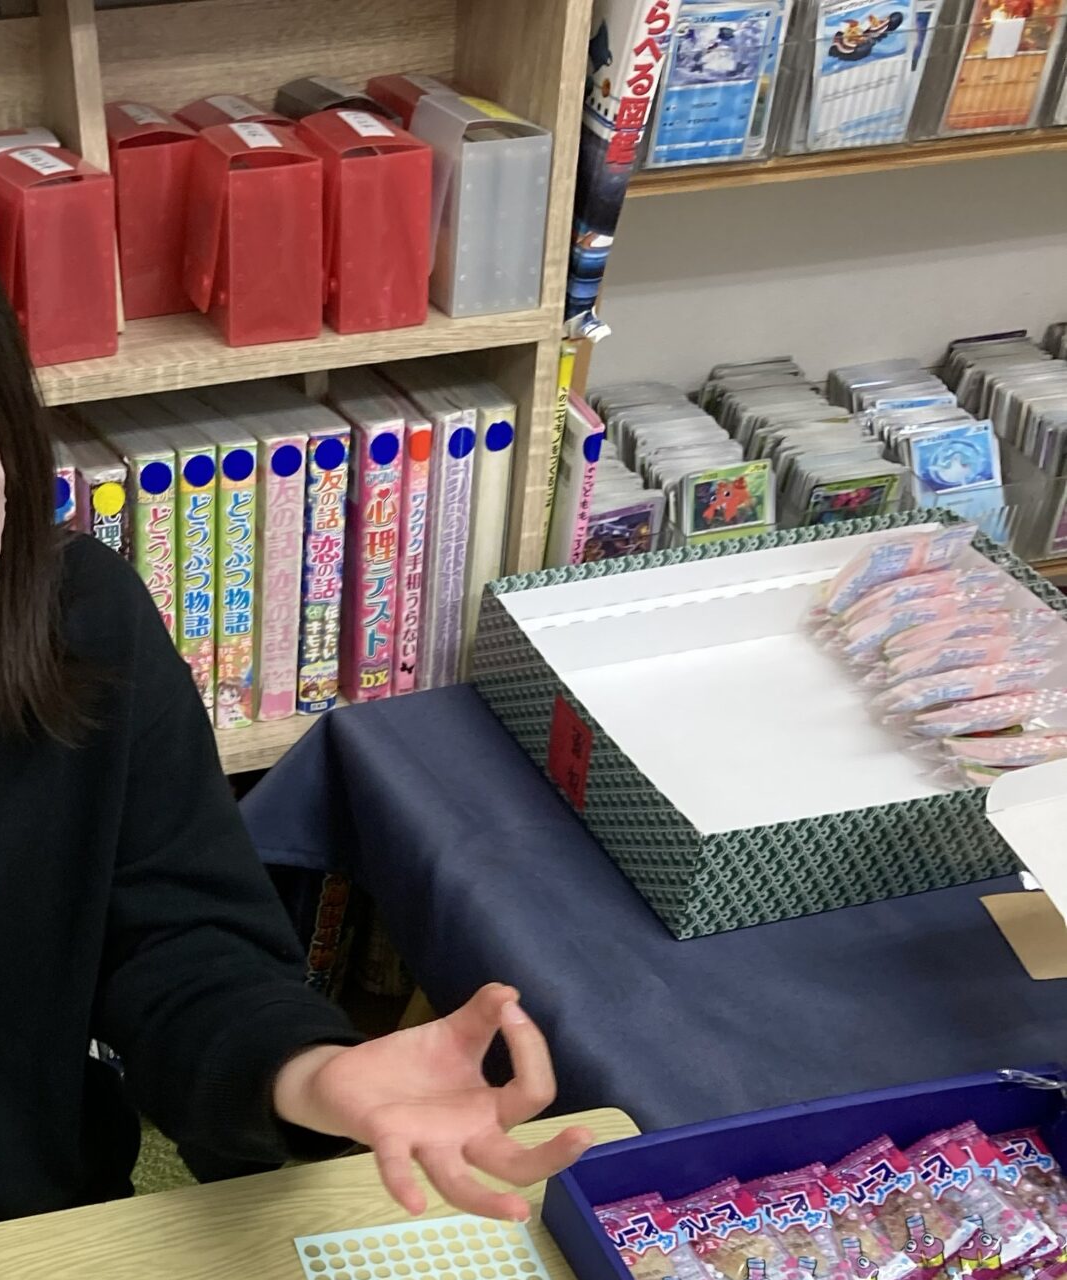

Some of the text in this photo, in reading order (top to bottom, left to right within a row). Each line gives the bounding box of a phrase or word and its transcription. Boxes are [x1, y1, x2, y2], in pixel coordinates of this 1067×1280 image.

[310, 468, 343, 600] 友の話 恋の話
[184, 494, 212, 639] どうぶつ物語
[224, 491, 254, 637] どうぶつ物語
[363, 487, 399, 658] 心理テスト
[401, 493, 427, 658] ワクワク手相うらない
[305, 621, 322, 662] キモチ
[360, 669, 389, 688] DX
[848, 1160, 898, 1205] レープ
[611, 1213, 659, 1247] レープ
[678, 1200, 742, 1238] グレープ
[709, 1216, 758, 1236] ソーダ
[770, 1210, 825, 1230] ソーダ
[627, 1232, 676, 1254] ソーダ
